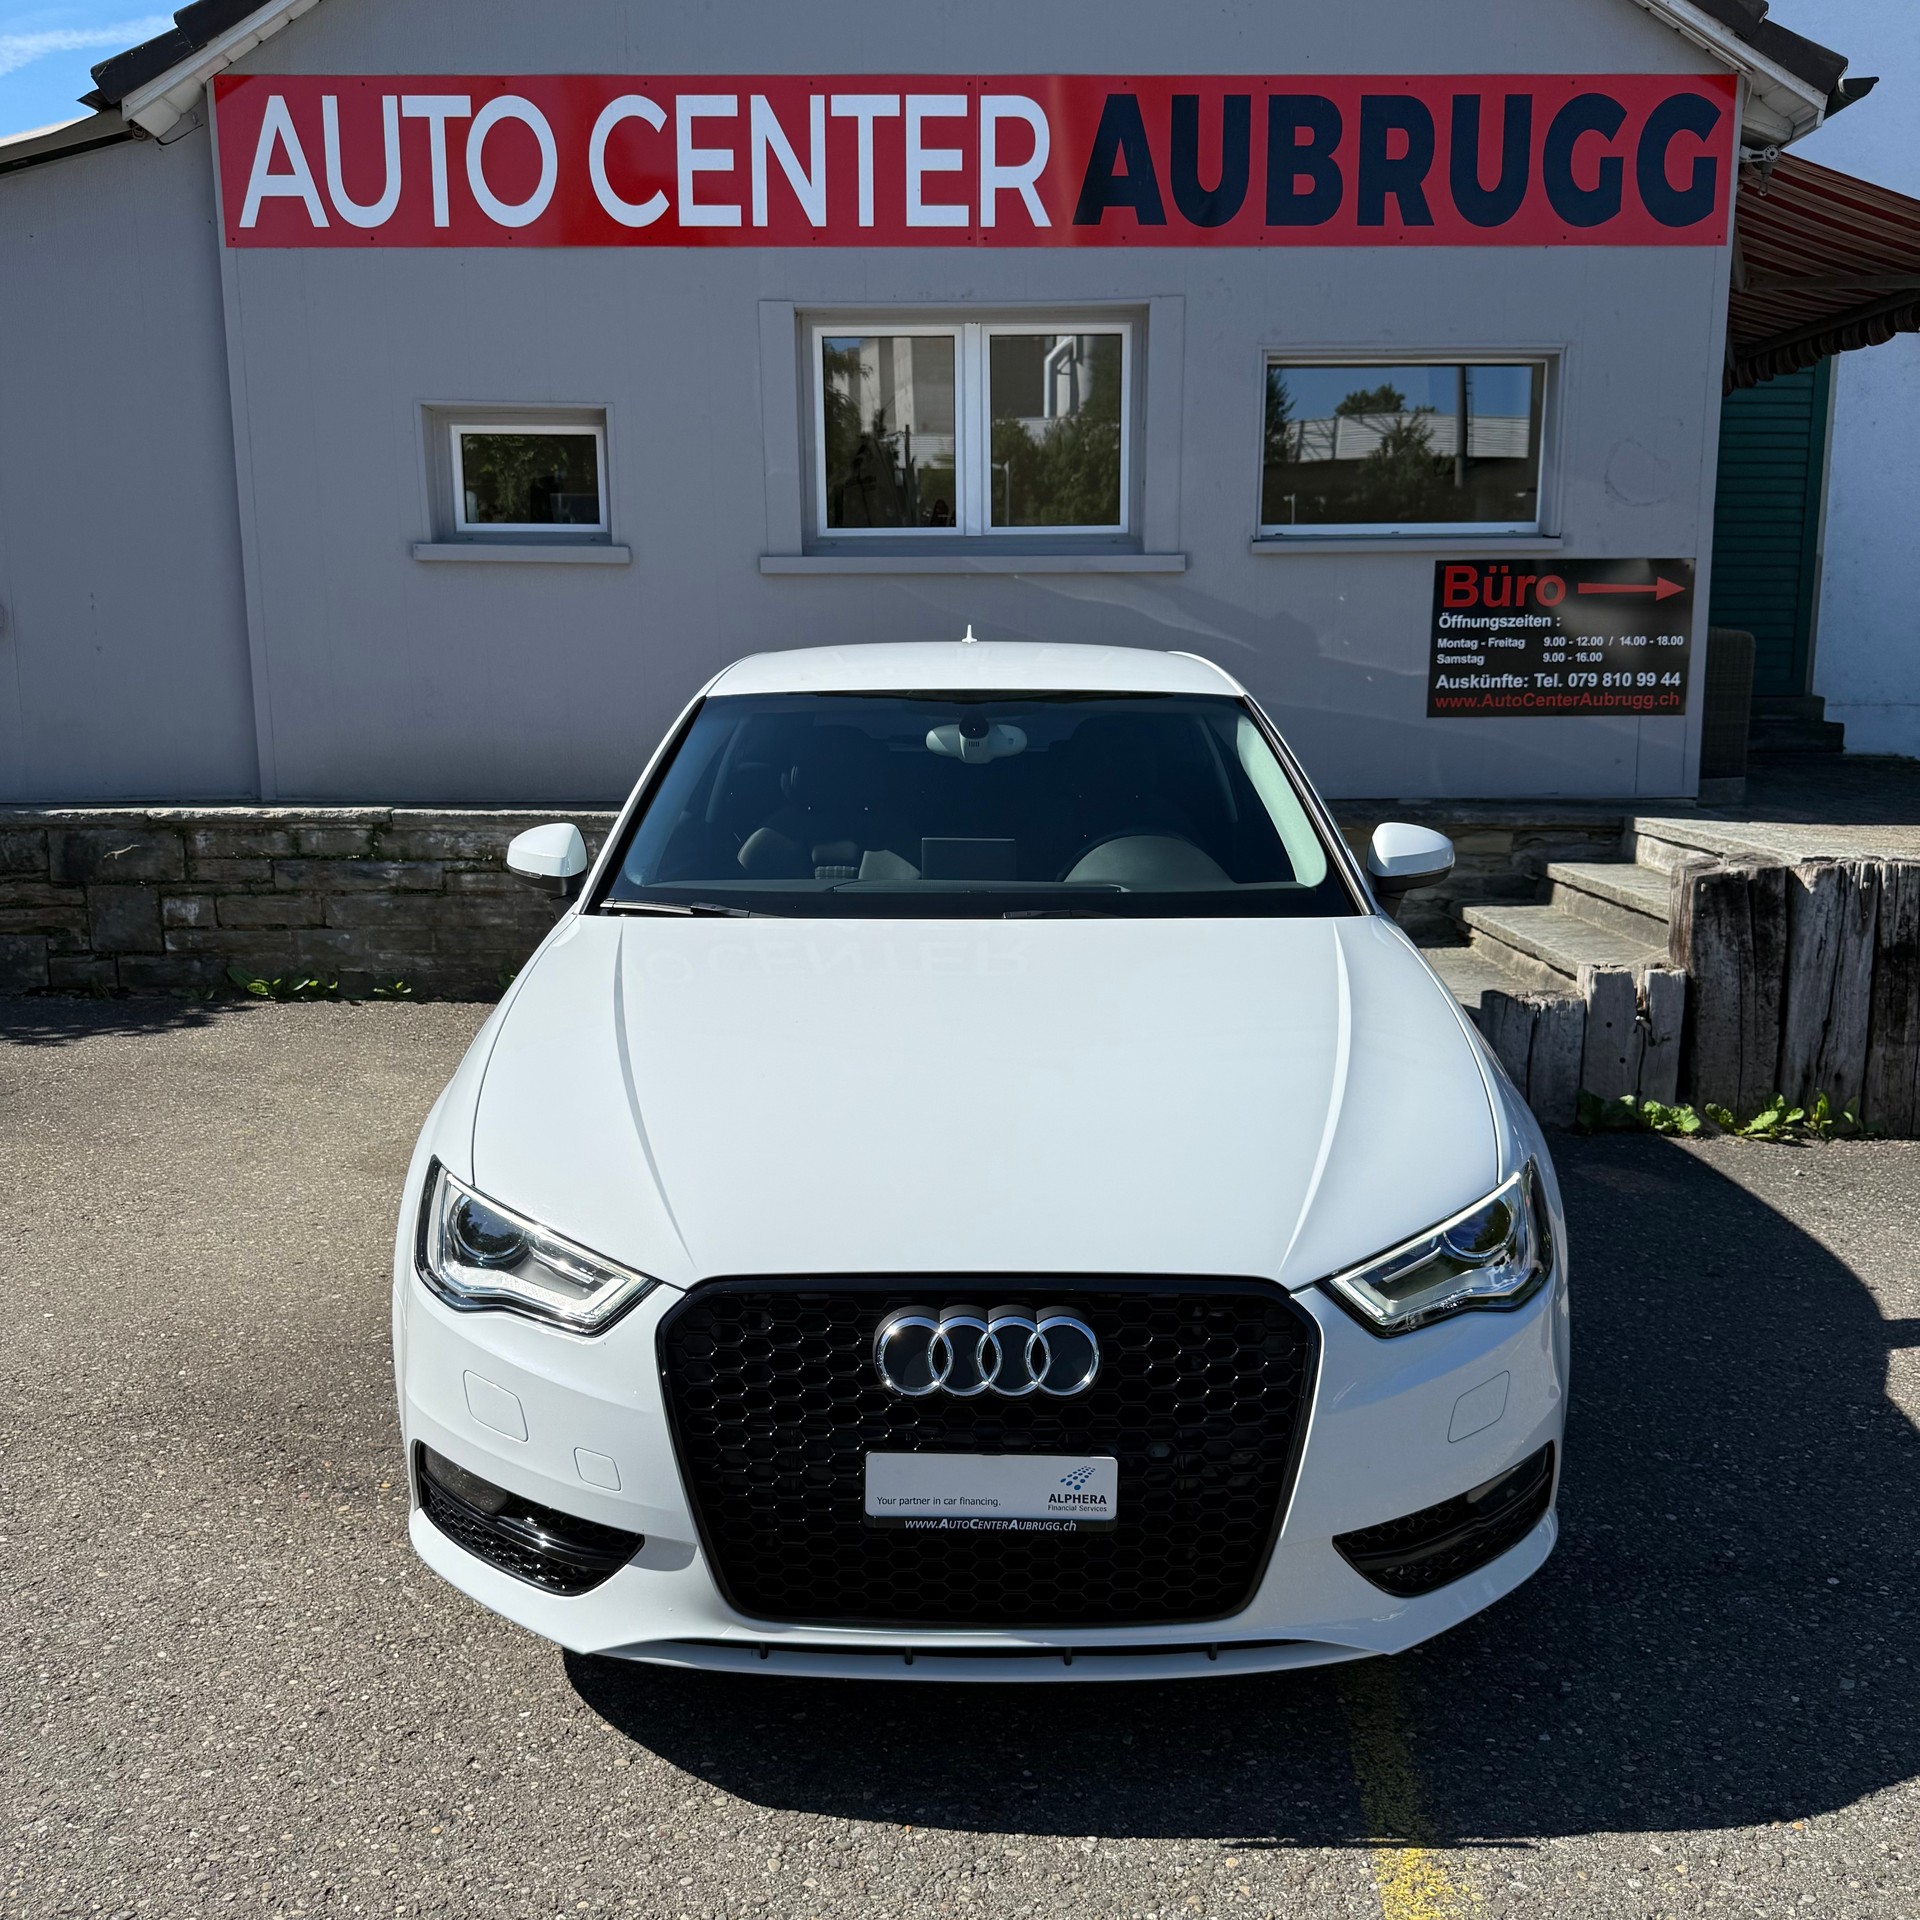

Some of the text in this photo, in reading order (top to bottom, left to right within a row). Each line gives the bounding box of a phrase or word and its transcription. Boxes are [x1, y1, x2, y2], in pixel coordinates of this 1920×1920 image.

[239, 92, 1722, 229] AUTO CENTER AUBRUGG
[1443, 565, 1566, 608] Büro
[1438, 612, 1552, 631] Öffnungszeiten
[1437, 638, 1478, 650] Montag
[1487, 637, 1526, 650] Freitag
[1543, 636, 1566, 647] 9.00
[1576, 636, 1604, 646] 12.00
[1619, 635, 1647, 646] 14.00
[1656, 635, 1684, 646] 18.00
[1436, 653, 1485, 666] Samstag
[1542, 652, 1565, 662] 9.00
[1575, 652, 1603, 662] 16.00
[1435, 671, 1681, 689] Auskünfte: Tel. 079 810 99 44
[1435, 691, 1680, 710] www.AutoCenterAubrugg.ch
[877, 1496, 896, 1505] Your
[899, 1497, 931, 1507] partner
[933, 1497, 941, 1505] in
[959, 1496, 1001, 1507] financing.
[1048, 1493, 1107, 1505] ALPHERA
